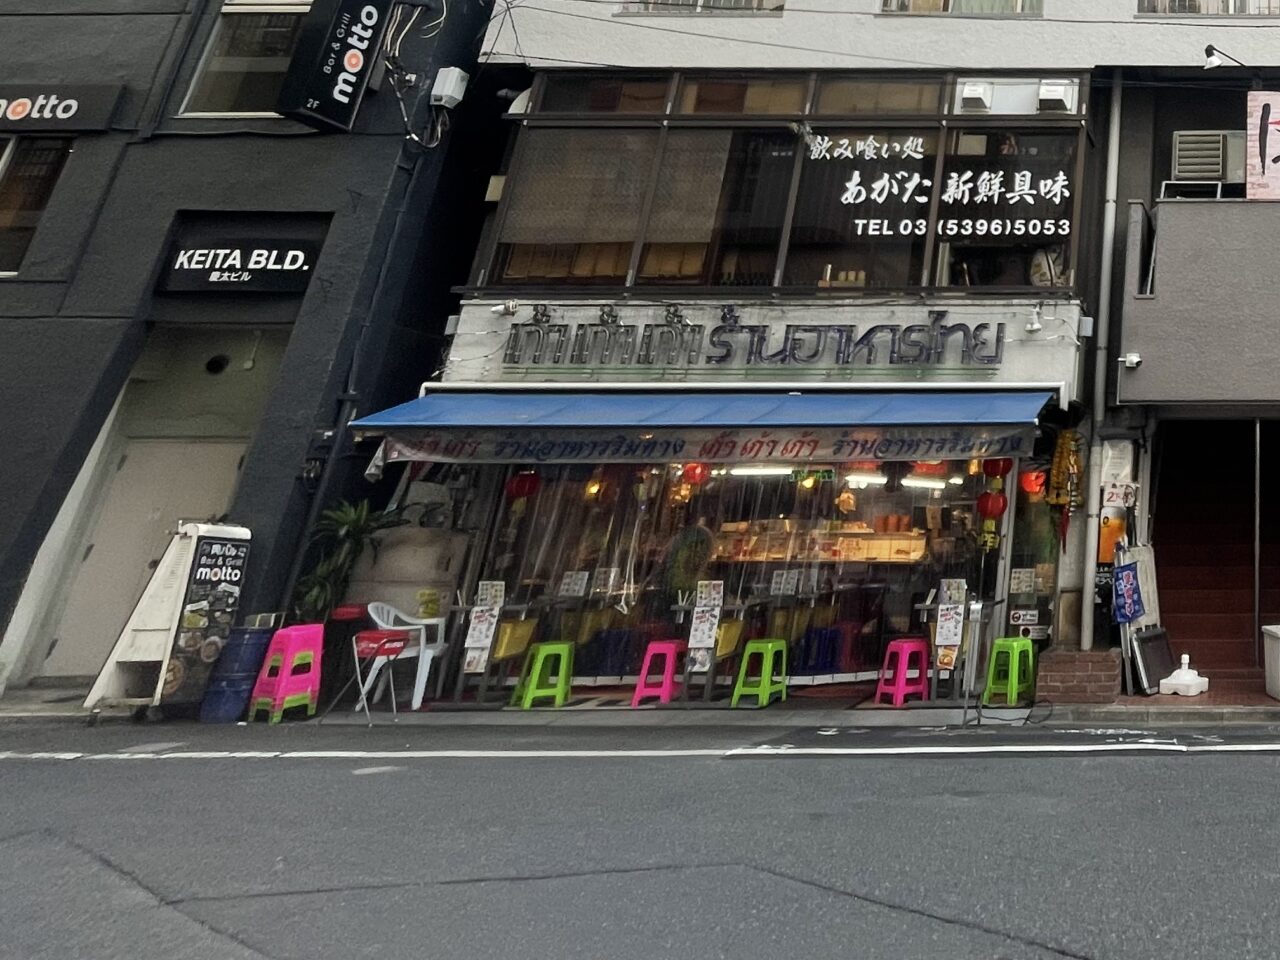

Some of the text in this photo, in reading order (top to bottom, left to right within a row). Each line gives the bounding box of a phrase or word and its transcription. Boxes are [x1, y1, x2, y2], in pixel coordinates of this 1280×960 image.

[331, 42, 341, 51] &
[333, 4, 379, 104] motto
[809, 135, 925, 161] 飲み喰い処
[840, 170, 933, 205] あがた
[855, 219, 1071, 236] TEL 03 (5396)5053
[174, 249, 310, 271] KEITA BLD.
[196, 566, 241, 582] motto
